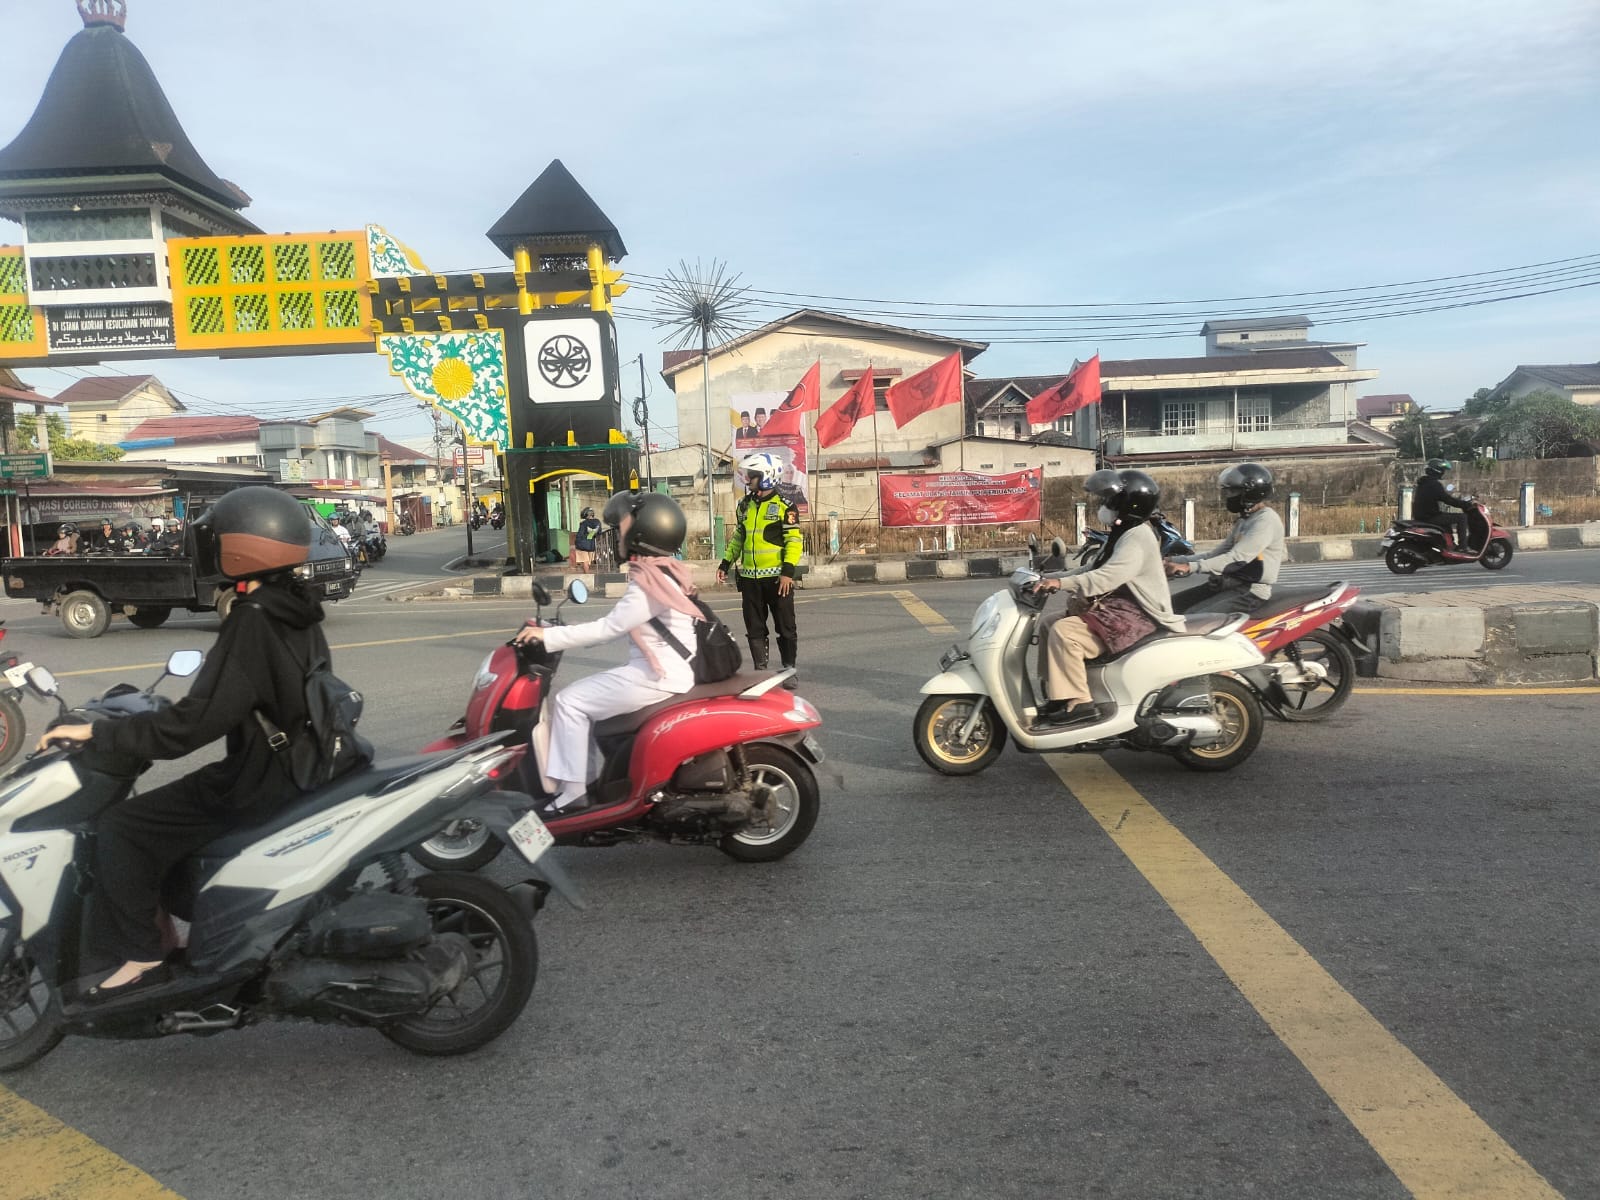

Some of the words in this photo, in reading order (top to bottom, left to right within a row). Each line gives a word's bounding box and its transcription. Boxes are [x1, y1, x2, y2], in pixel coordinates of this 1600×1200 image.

[52, 322, 59, 331] DI
[61, 321, 80, 331] ISTANA
[80, 320, 104, 330] KADRIAH
[105, 319, 138, 329] KESULTANAN
[140, 317, 170, 328] PONTIANAK
[38, 500, 60, 510] NASI
[63, 499, 99, 510] GORENG
[3, 844, 48, 862] HONDA
